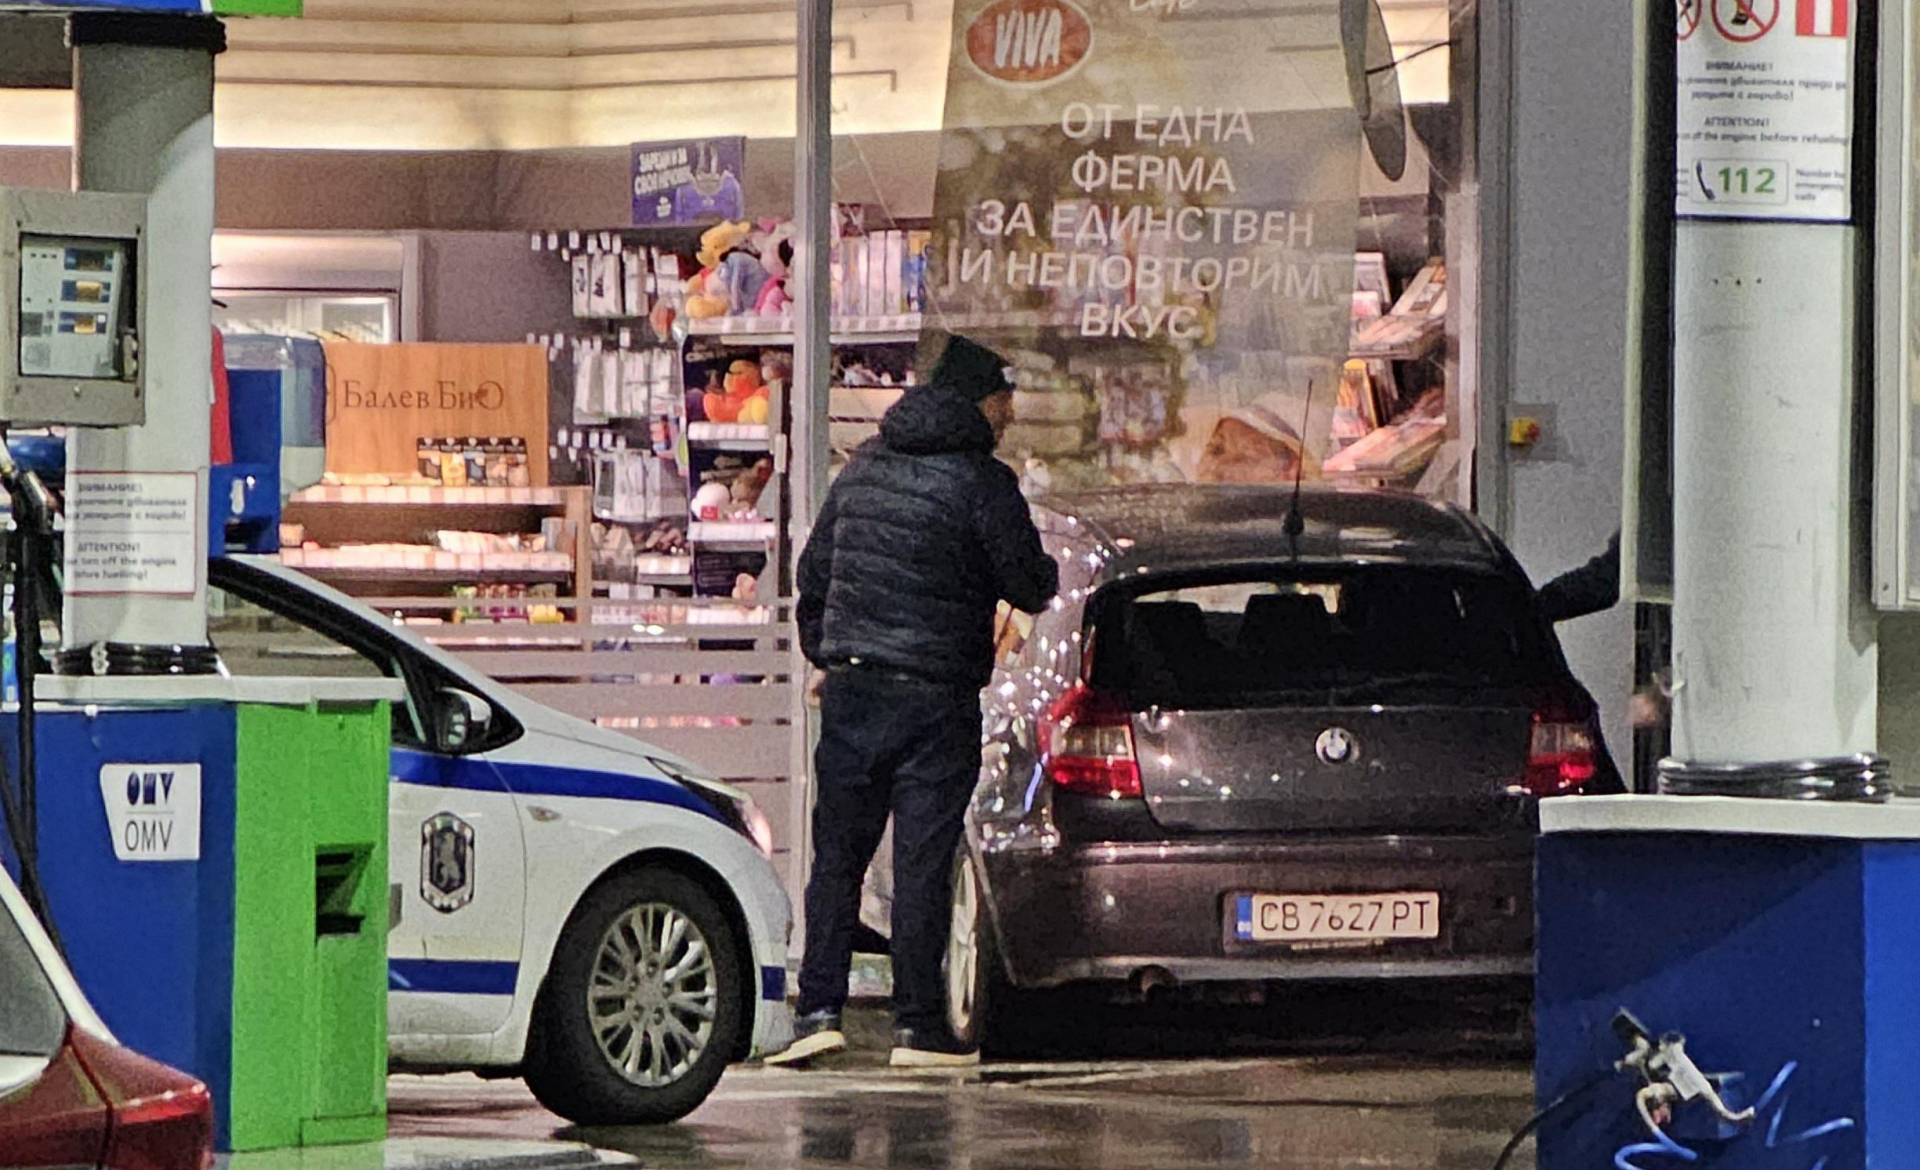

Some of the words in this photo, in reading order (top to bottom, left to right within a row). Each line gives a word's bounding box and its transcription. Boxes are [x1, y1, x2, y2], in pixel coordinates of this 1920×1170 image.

[994, 8, 1062, 68] VIVA
[1062, 102, 1121, 139] ОТ
[1135, 105, 1254, 147] ЕДНА
[1704, 117, 1769, 127] ATTENTION!
[1761, 132, 1798, 142] before
[1071, 150, 1236, 193] ФЕРМА
[1718, 166, 1776, 194] 112
[977, 200, 1036, 237] ЗА
[1051, 203, 1314, 247] ЕДИНСТВЕН
[960, 248, 992, 284] И
[1006, 250, 1322, 299] НЕПОВТОРИМ
[1081, 303, 1201, 339] ВКУС
[342, 380, 430, 408] Балев
[77, 543, 140, 552] ATTENTION!
[101, 556, 116, 565] off
[120, 556, 137, 565] the
[126, 771, 174, 806] OMV
[125, 820, 173, 852] OMV
[1260, 902, 1300, 932] CB
[1309, 902, 1384, 932] 7627
[1392, 900, 1431, 931] PT
